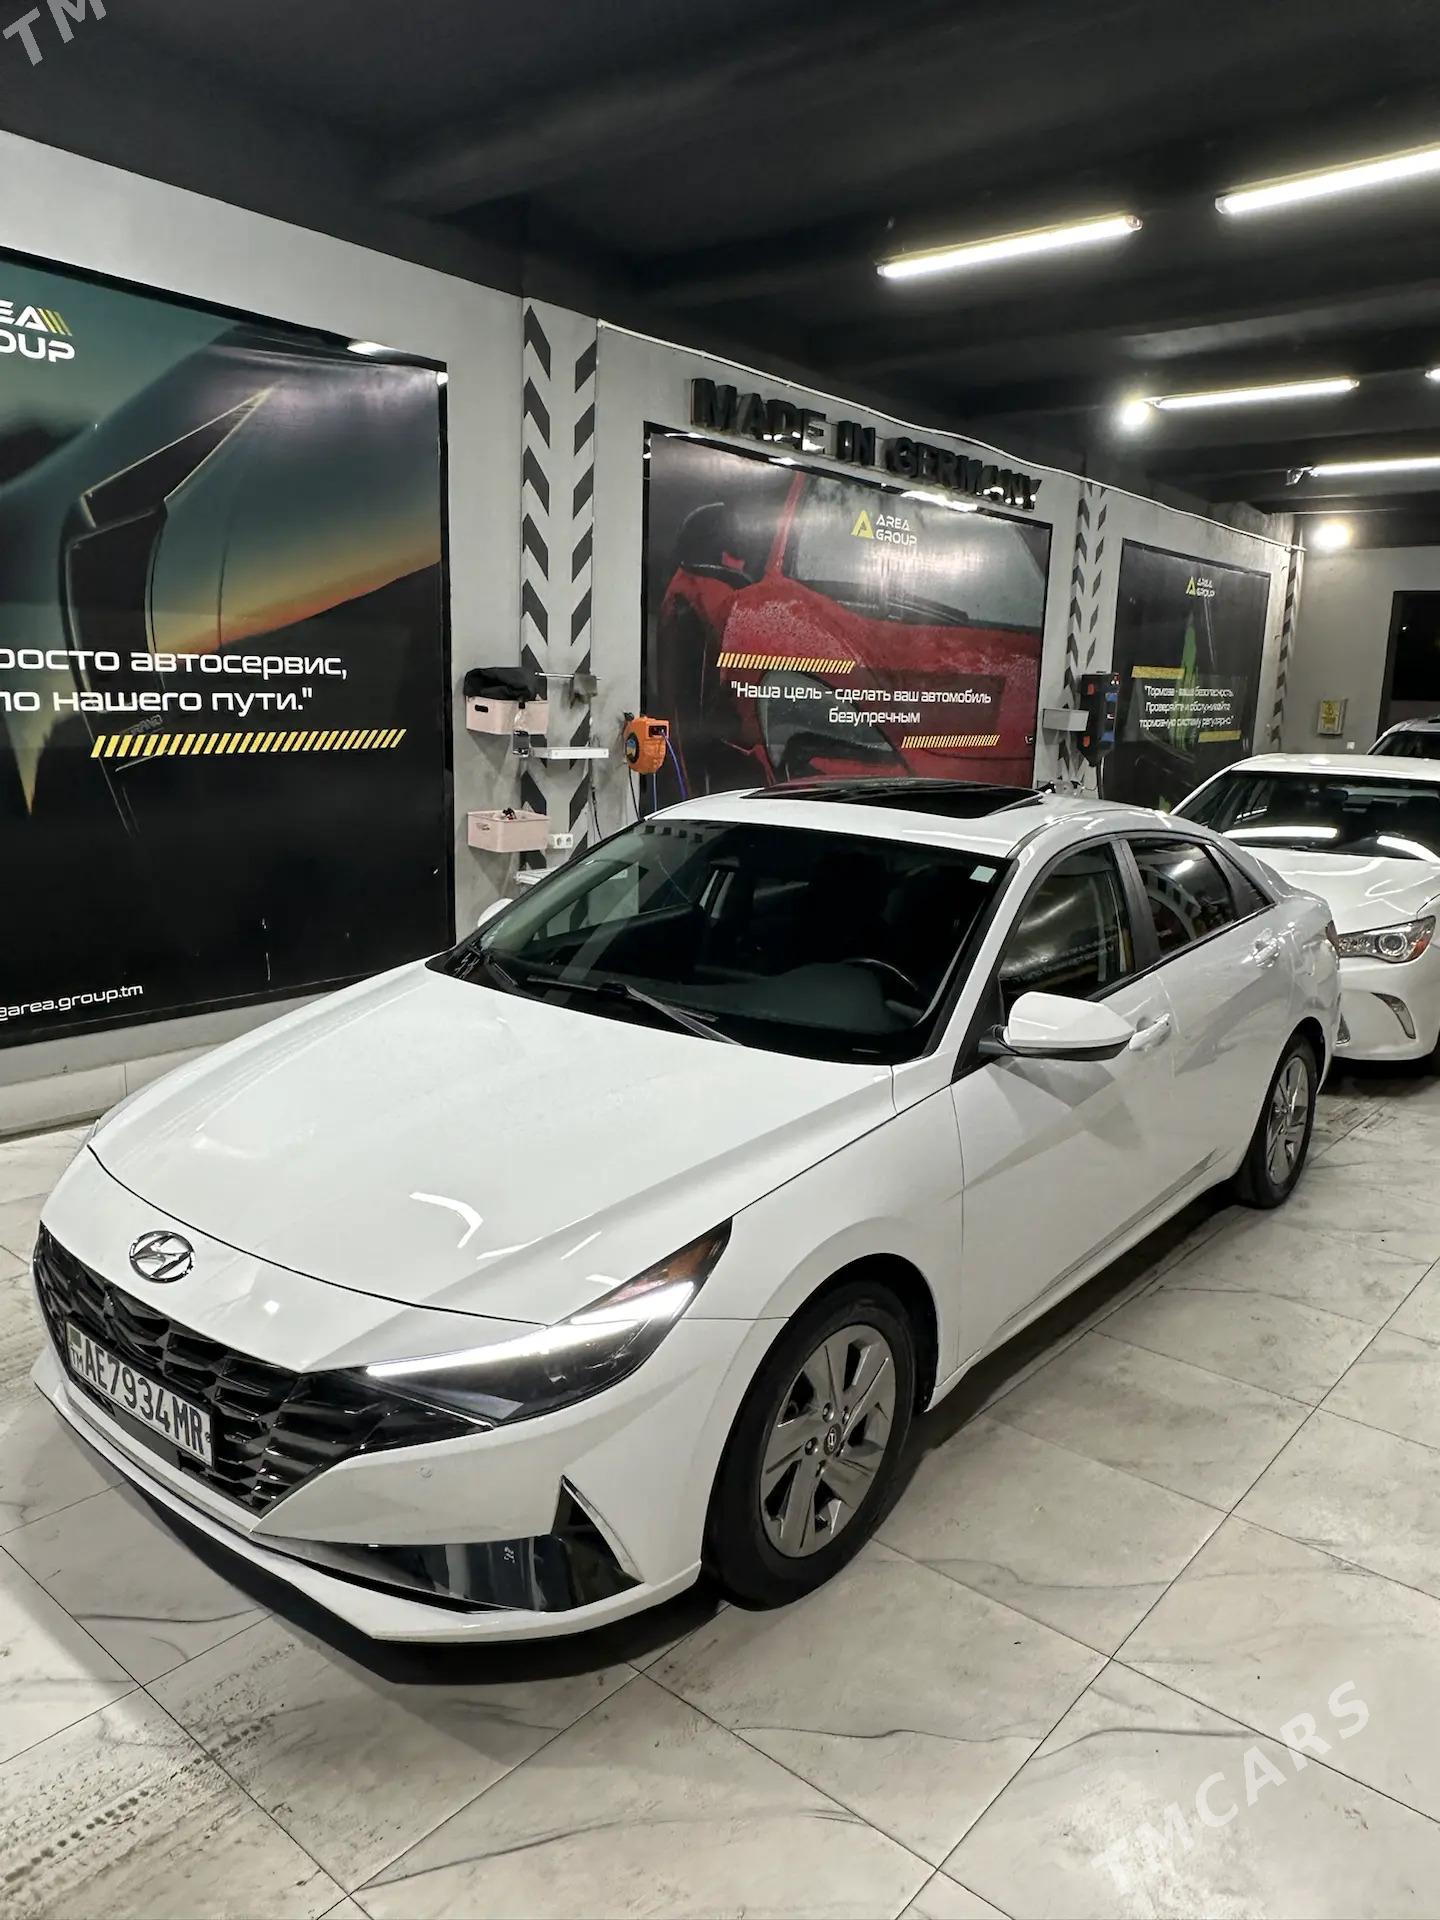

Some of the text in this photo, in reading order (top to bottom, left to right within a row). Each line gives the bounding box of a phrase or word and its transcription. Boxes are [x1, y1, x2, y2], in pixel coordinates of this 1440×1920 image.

[690, 377, 1042, 511] MADE IN GERMANY
[875, 513, 911, 531] AREA
[875, 528, 918, 547] GROUP
[130, 651, 347, 681] автосервис,
[52, 690, 203, 713] нашего
[211, 686, 313, 718] пути."
[730, 680, 781, 700] "Наша
[783, 685, 823, 703] цель
[834, 688, 891, 704] сделать
[893, 690, 919, 702] ваш
[920, 688, 992, 704] автомобиль
[828, 705, 921, 728] безупречным
[84, 1338, 205, 1456] AE7934MR
